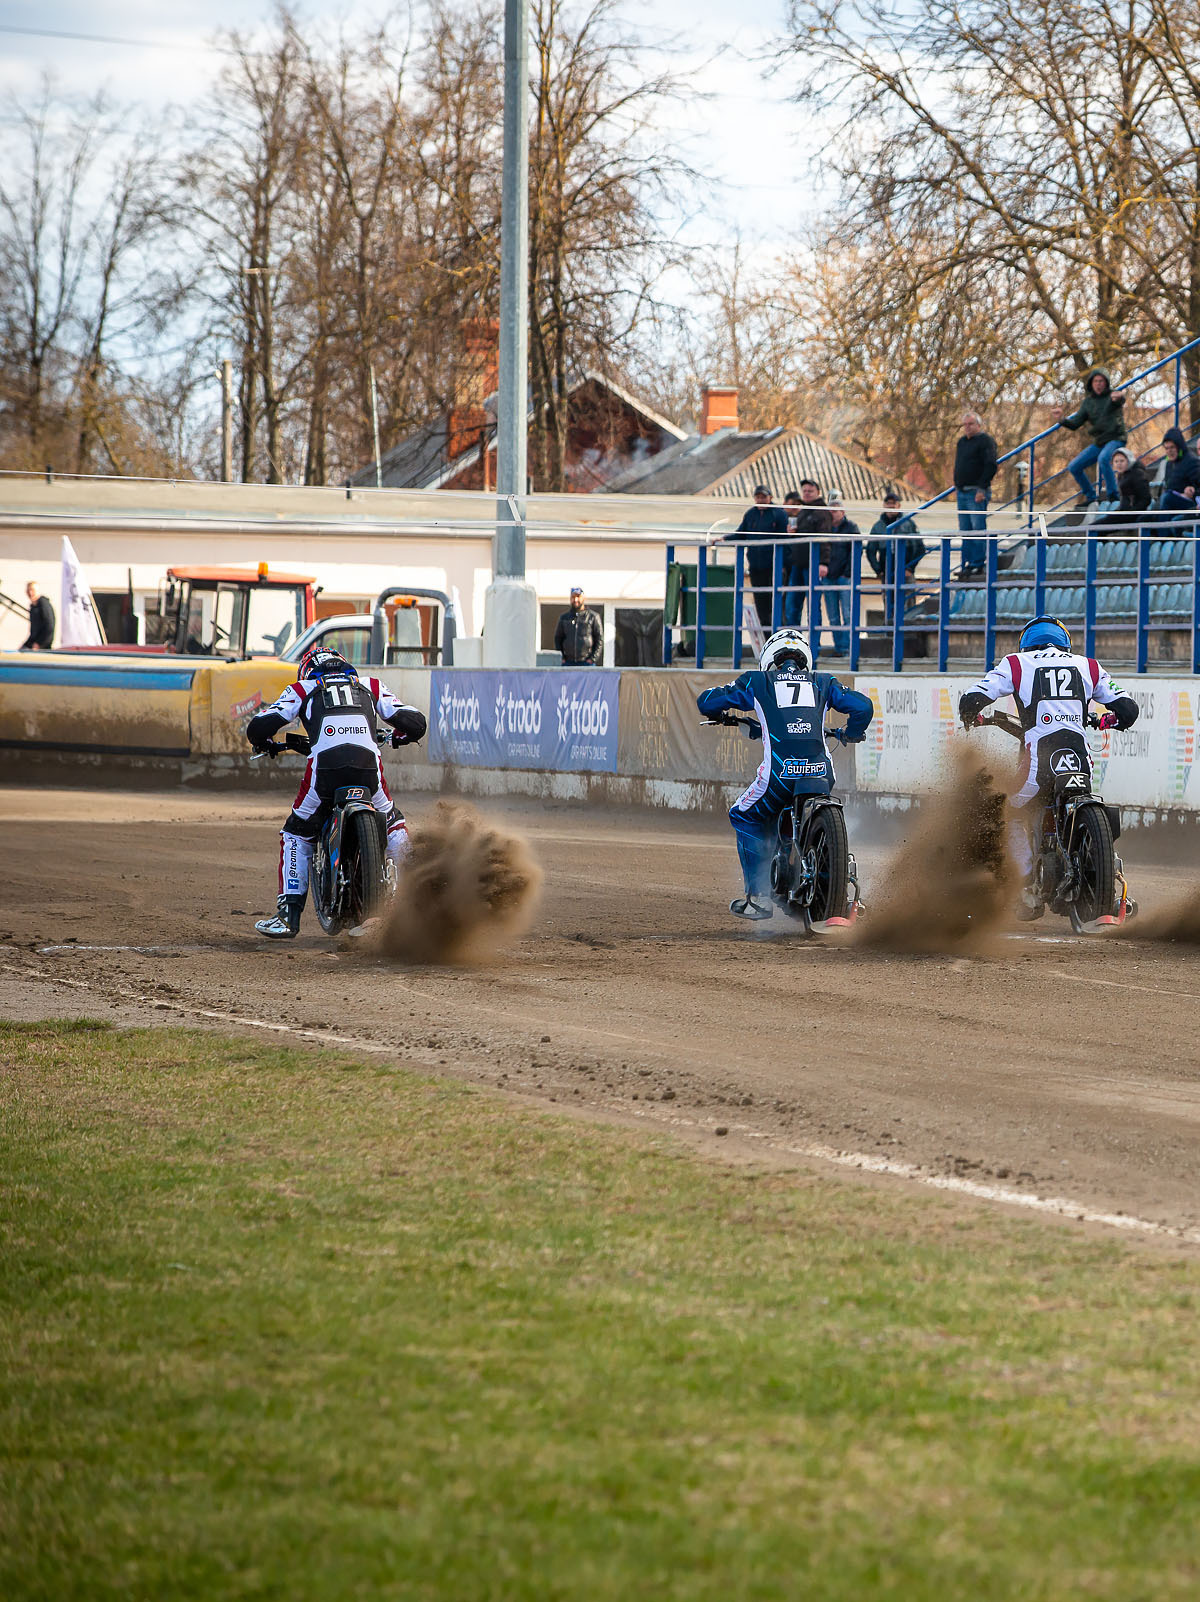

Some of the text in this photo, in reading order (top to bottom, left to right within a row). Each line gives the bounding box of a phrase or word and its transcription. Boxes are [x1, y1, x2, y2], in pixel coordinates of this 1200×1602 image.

[327, 684, 354, 706] 11
[786, 683, 801, 705] 7
[1045, 668, 1073, 697] 12
[452, 690, 481, 732] trodo
[507, 690, 542, 735] trodo
[570, 690, 609, 737] trodo
[337, 726, 368, 734] OPTIBET
[346, 788, 364, 800] 12
